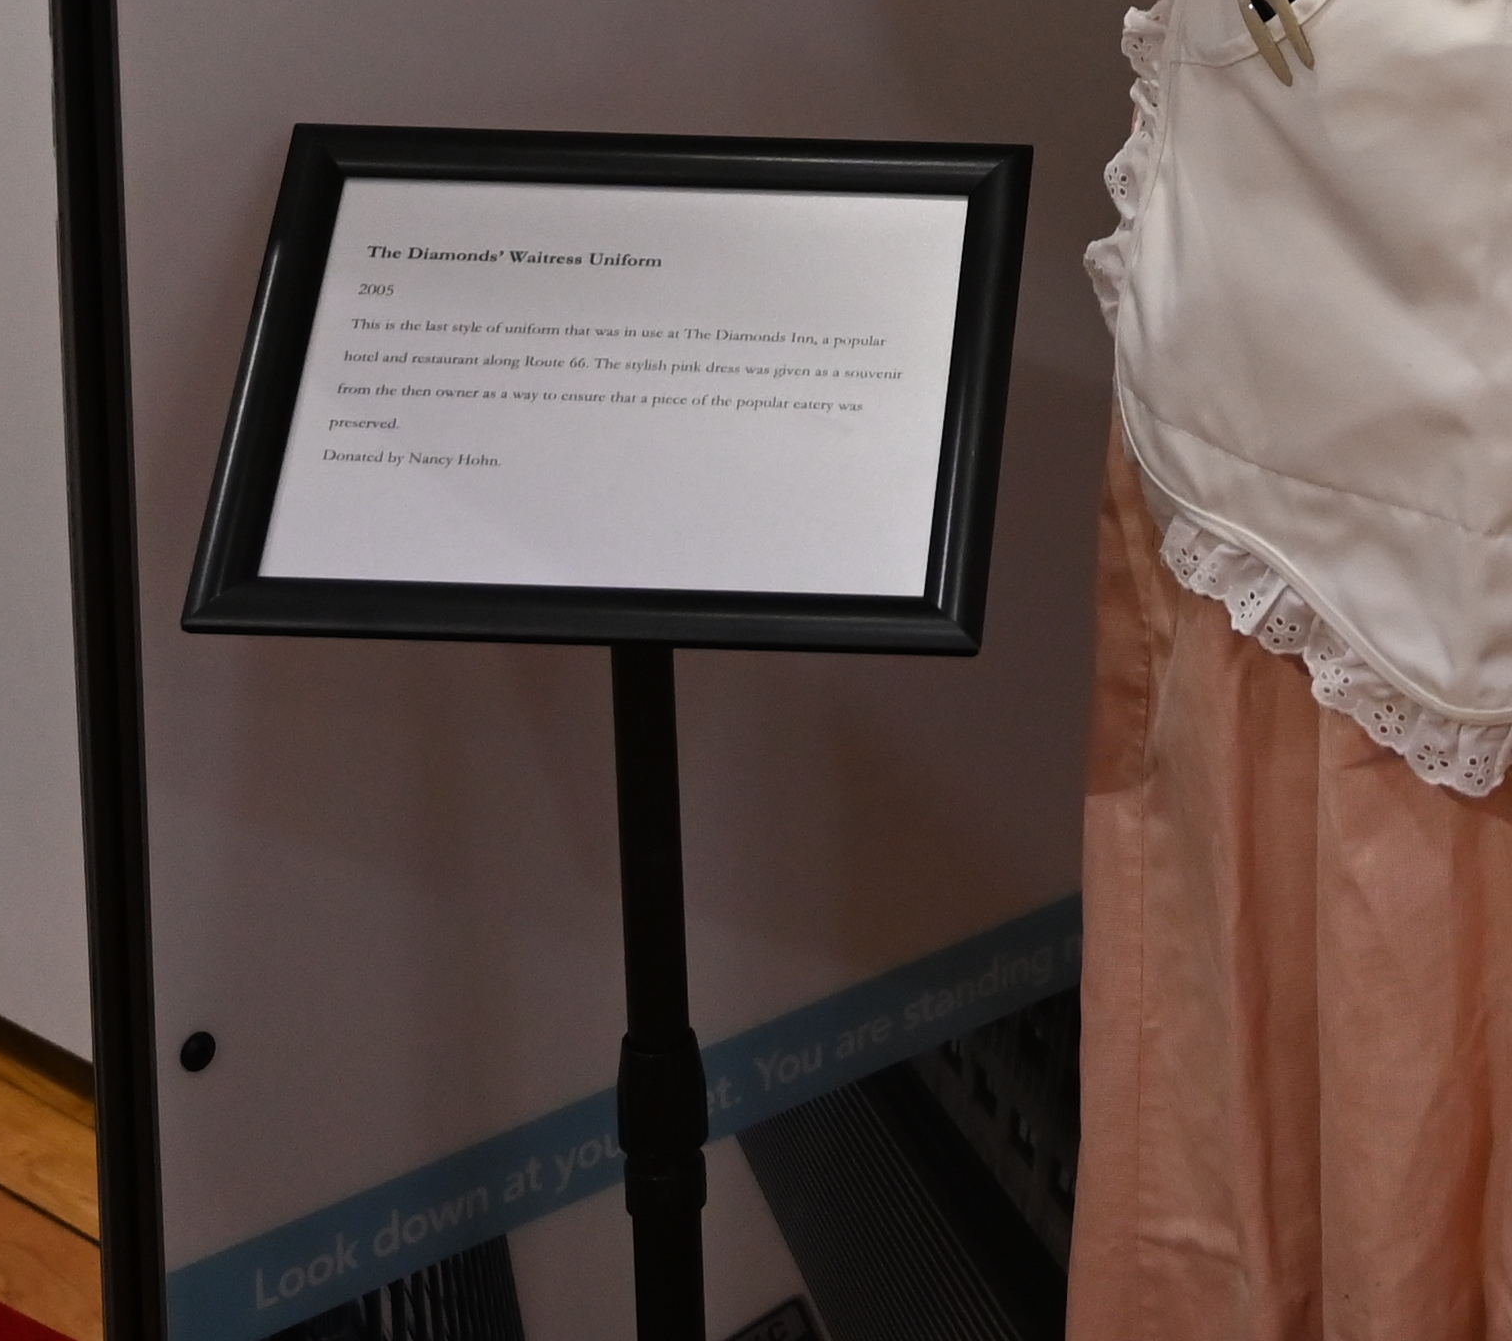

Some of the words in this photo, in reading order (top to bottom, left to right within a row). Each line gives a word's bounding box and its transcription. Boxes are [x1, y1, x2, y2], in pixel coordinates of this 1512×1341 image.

[367, 244, 403, 260] The
[407, 246, 505, 264] Diamonds'
[508, 249, 584, 266] Waitress
[588, 251, 663, 269] Uniform
[357, 282, 395, 297] 2005
[350, 317, 382, 331] This
[399, 318, 422, 332] the
[424, 319, 449, 333] last
[451, 320, 483, 337] style
[504, 321, 561, 336] uniform
[564, 324, 591, 337] that
[594, 327, 620, 338] was
[641, 328, 664, 339] use
[684, 327, 712, 341] The
[715, 328, 787, 343] Diamonds
[790, 331, 819, 346] Inn,
[832, 334, 887, 349] popular
[343, 349, 379, 363] hotel
[381, 350, 409, 364] and
[411, 352, 480, 366] restaurant
[482, 354, 521, 370] along
[524, 355, 566, 369] Route
[568, 356, 590, 370] 66.
[593, 357, 623, 371] The
[624, 359, 668, 374] stylish
[670, 361, 702, 376] pink
[704, 361, 741, 376] dress
[744, 365, 771, 376] was
[772, 364, 811, 379] given
[843, 368, 904, 381] souvenir
[336, 382, 372, 396] from
[374, 383, 398, 397] the
[400, 384, 432, 399] then
[435, 387, 480, 399] owner
[512, 389, 539, 404] way
[560, 391, 607, 403] ensure
[609, 390, 638, 405] that
[650, 392, 689, 409] piece
[710, 393, 733, 408] the
[735, 395, 791, 412] popular
[792, 398, 835, 414] eatery
[837, 401, 864, 413] was
[327, 416, 401, 432] preserved.
[321, 448, 384, 465] Donated
[408, 451, 455, 470] Nancy
[753, 1039, 824, 1095] You
[837, 1013, 892, 1060] are
[903, 937, 1053, 1036] standing
[254, 1241, 359, 1310] Look
[372, 1181, 491, 1260] down
[503, 1156, 543, 1203] at
